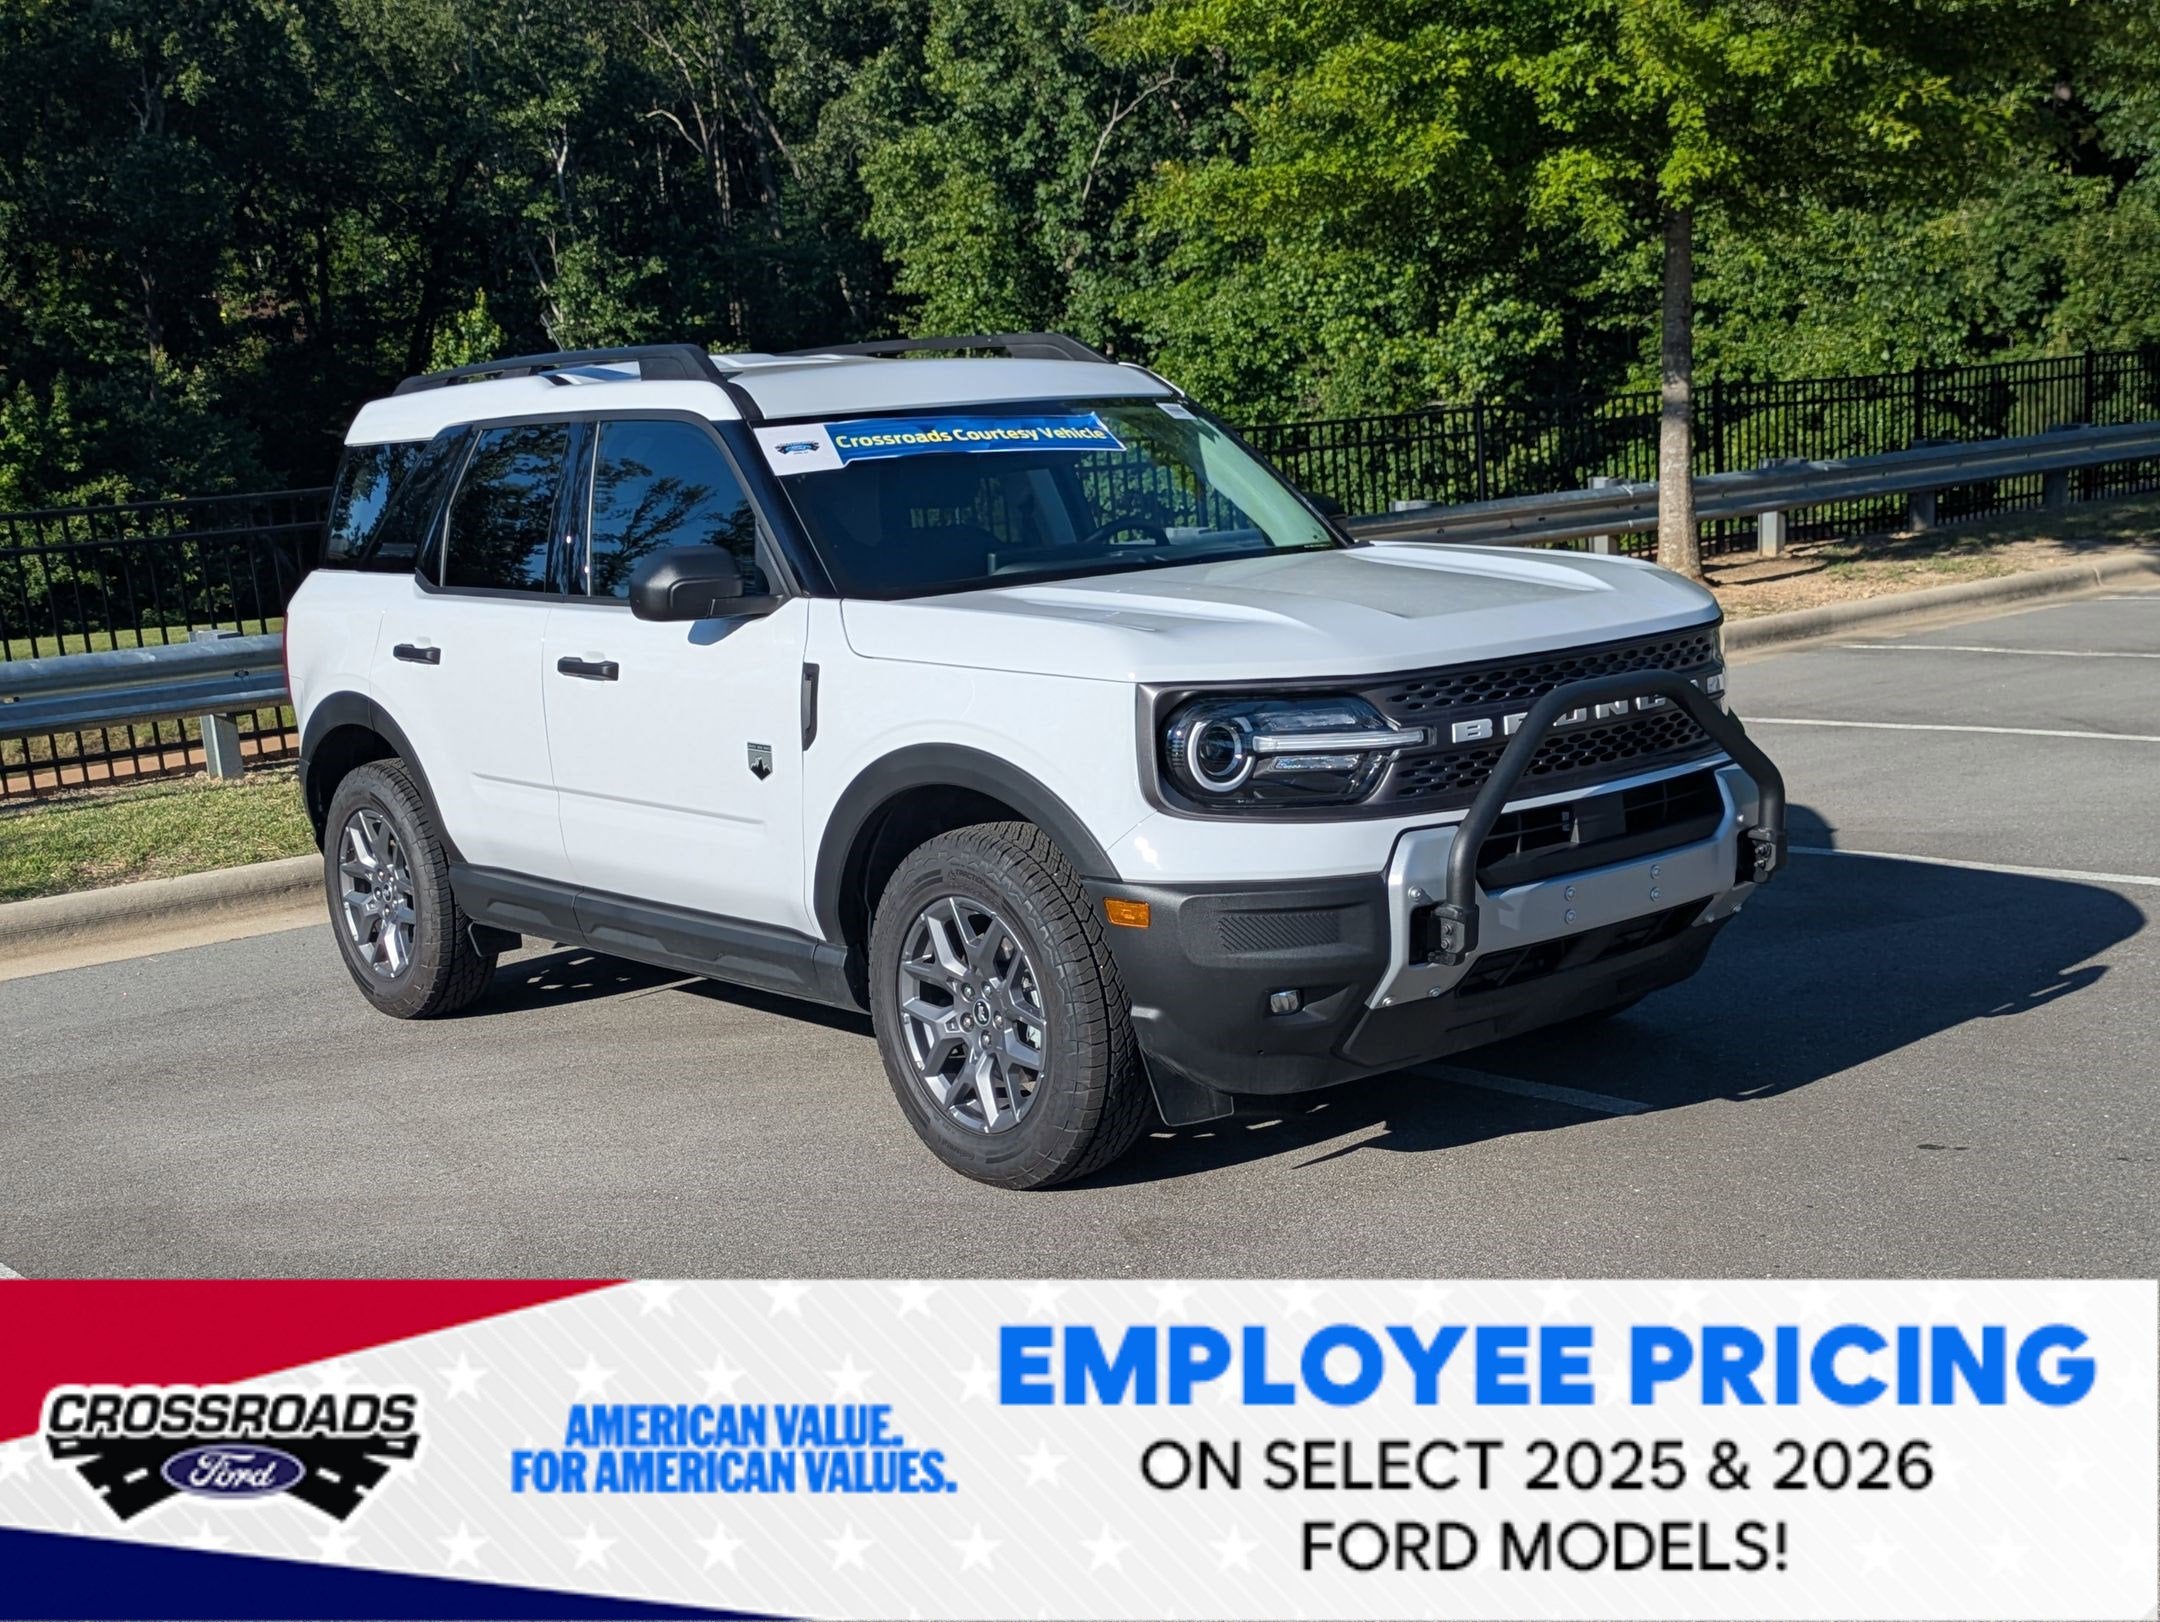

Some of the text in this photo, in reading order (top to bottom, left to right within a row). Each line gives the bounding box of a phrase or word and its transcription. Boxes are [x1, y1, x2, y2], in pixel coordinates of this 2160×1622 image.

[835, 429, 952, 449] Crossroads
[952, 426, 1038, 443] Courtesy
[1042, 425, 1107, 441] Vehicle
